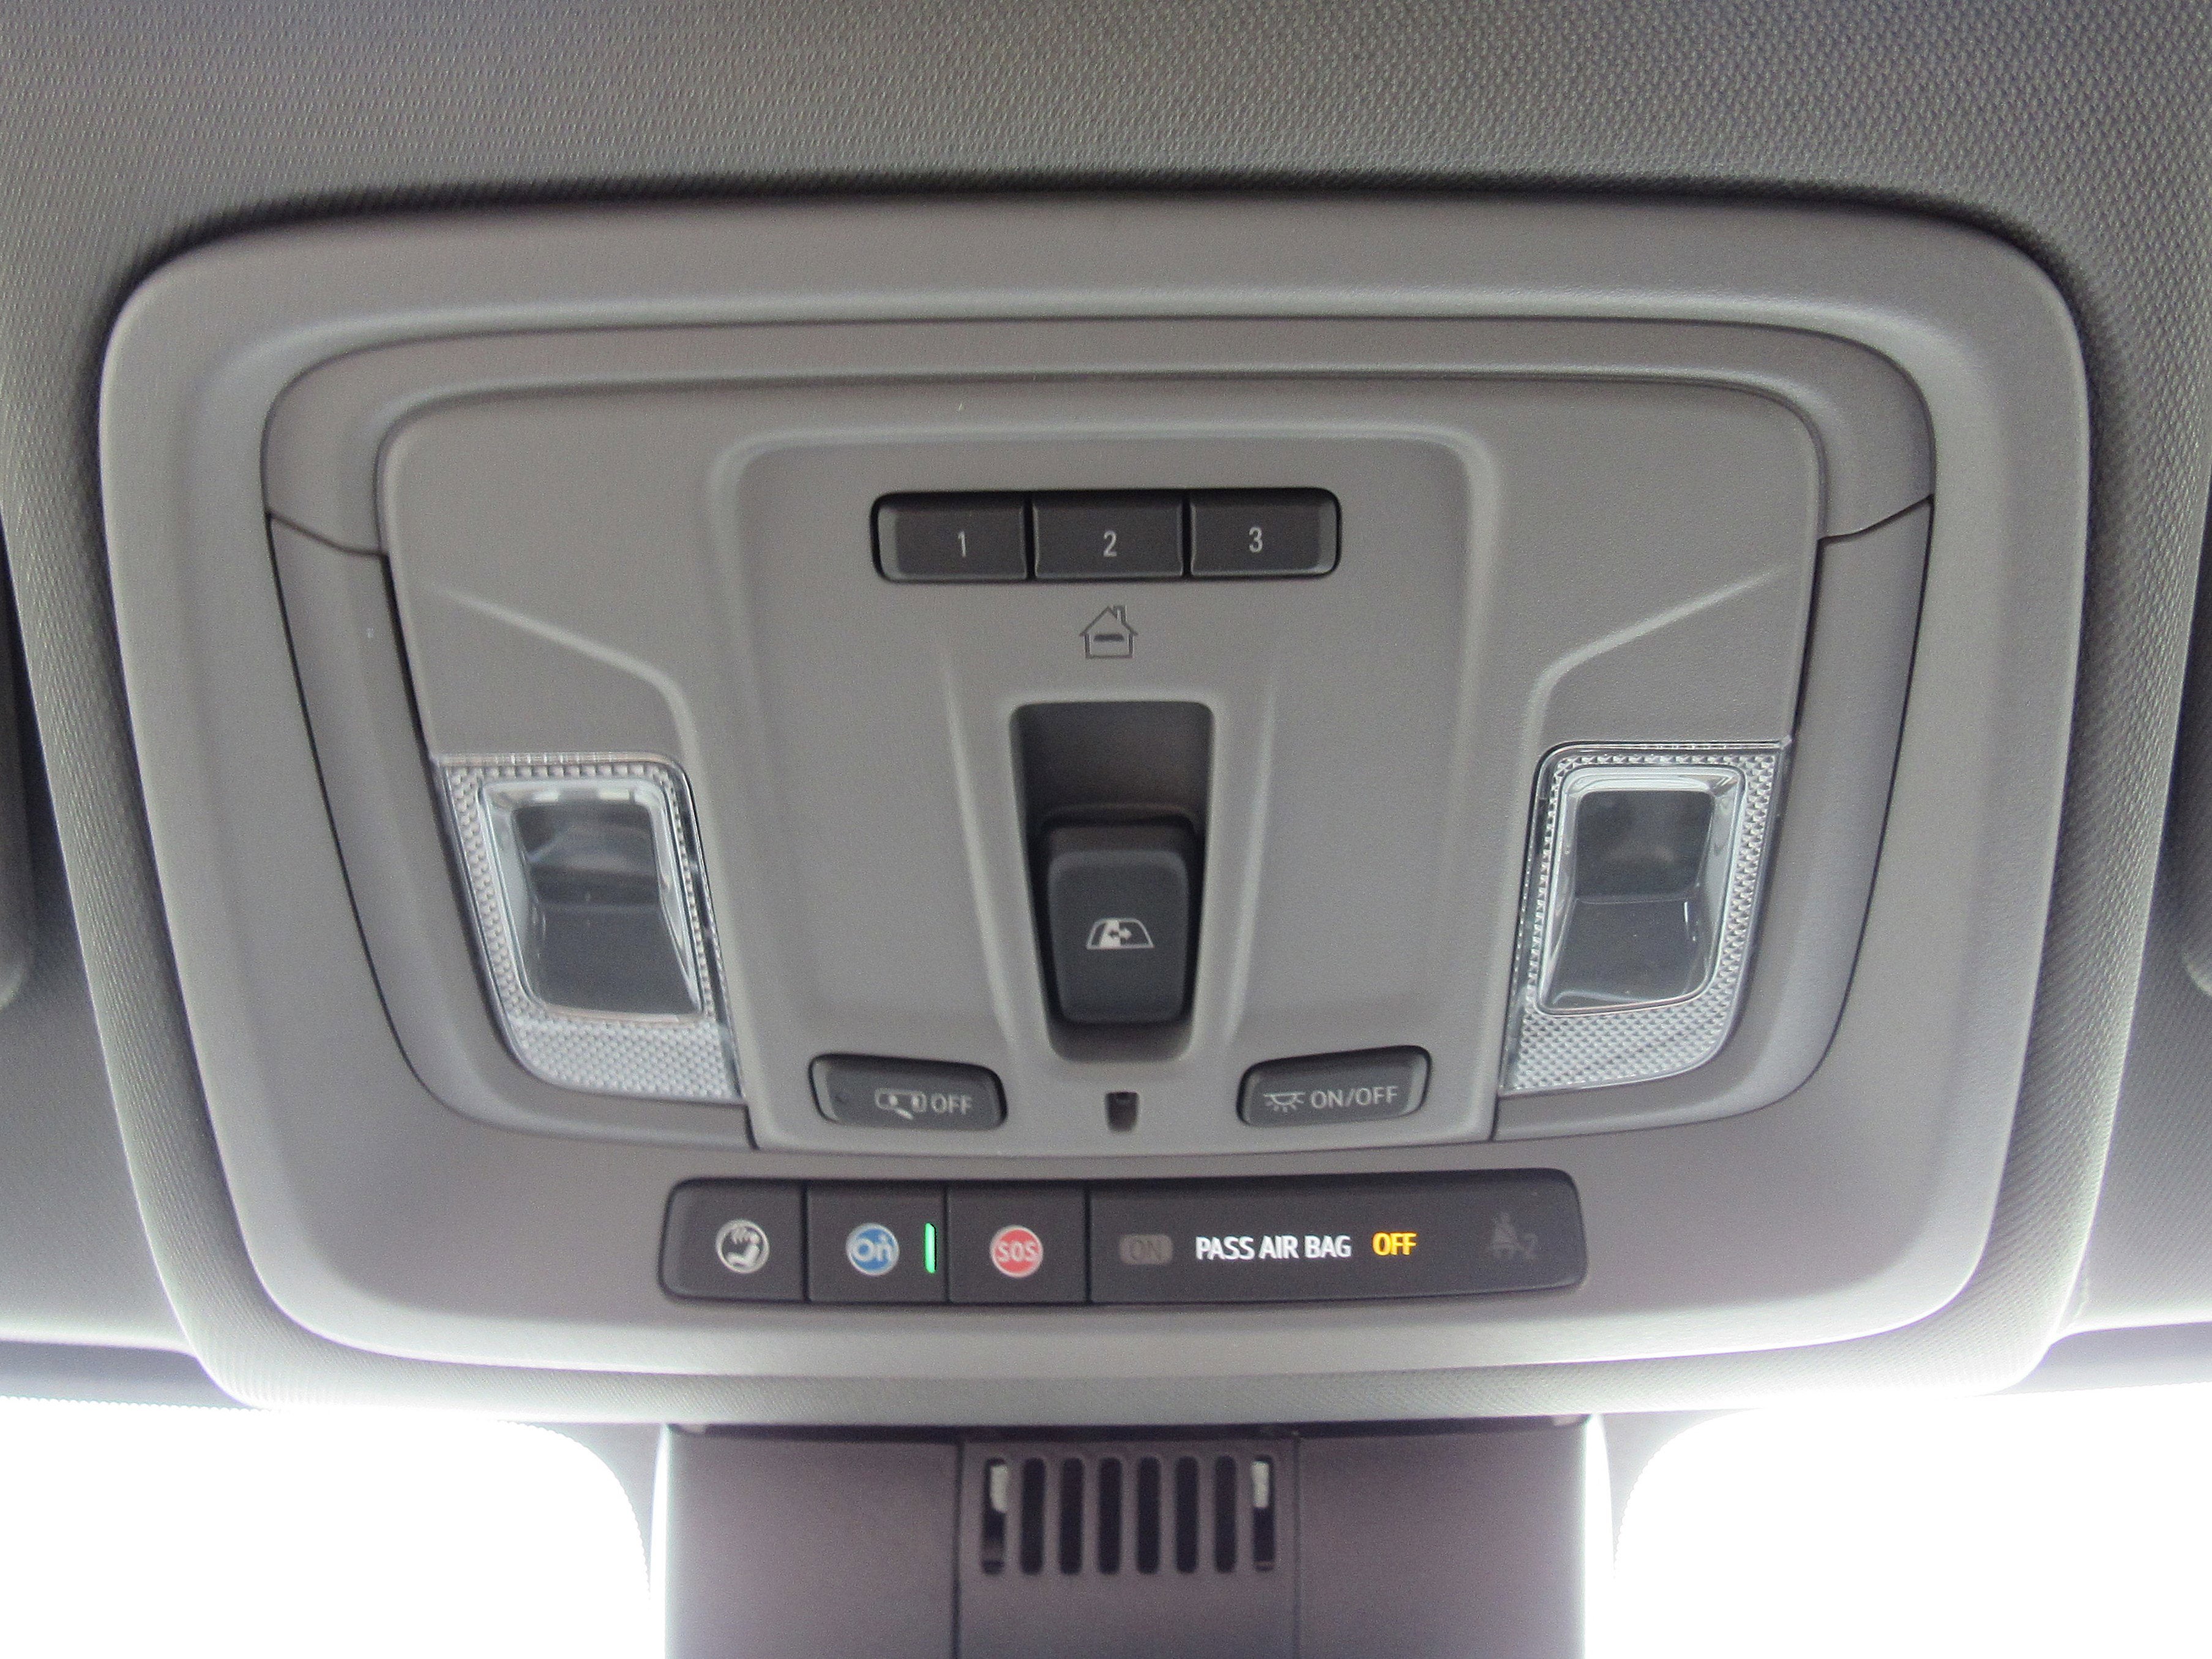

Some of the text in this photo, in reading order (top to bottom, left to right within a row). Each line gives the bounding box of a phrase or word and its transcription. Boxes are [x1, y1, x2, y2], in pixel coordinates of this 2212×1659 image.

[957, 531, 967, 557] 1
[1102, 531, 1118, 558] 2
[1249, 526, 1263, 553] 3
[931, 1094, 972, 1115] OFF
[1310, 1086, 1398, 1109] ON/OFF
[996, 1241, 1036, 1264] SOS
[1129, 1232, 1417, 1260] ON PASS AIR BAG OFF
